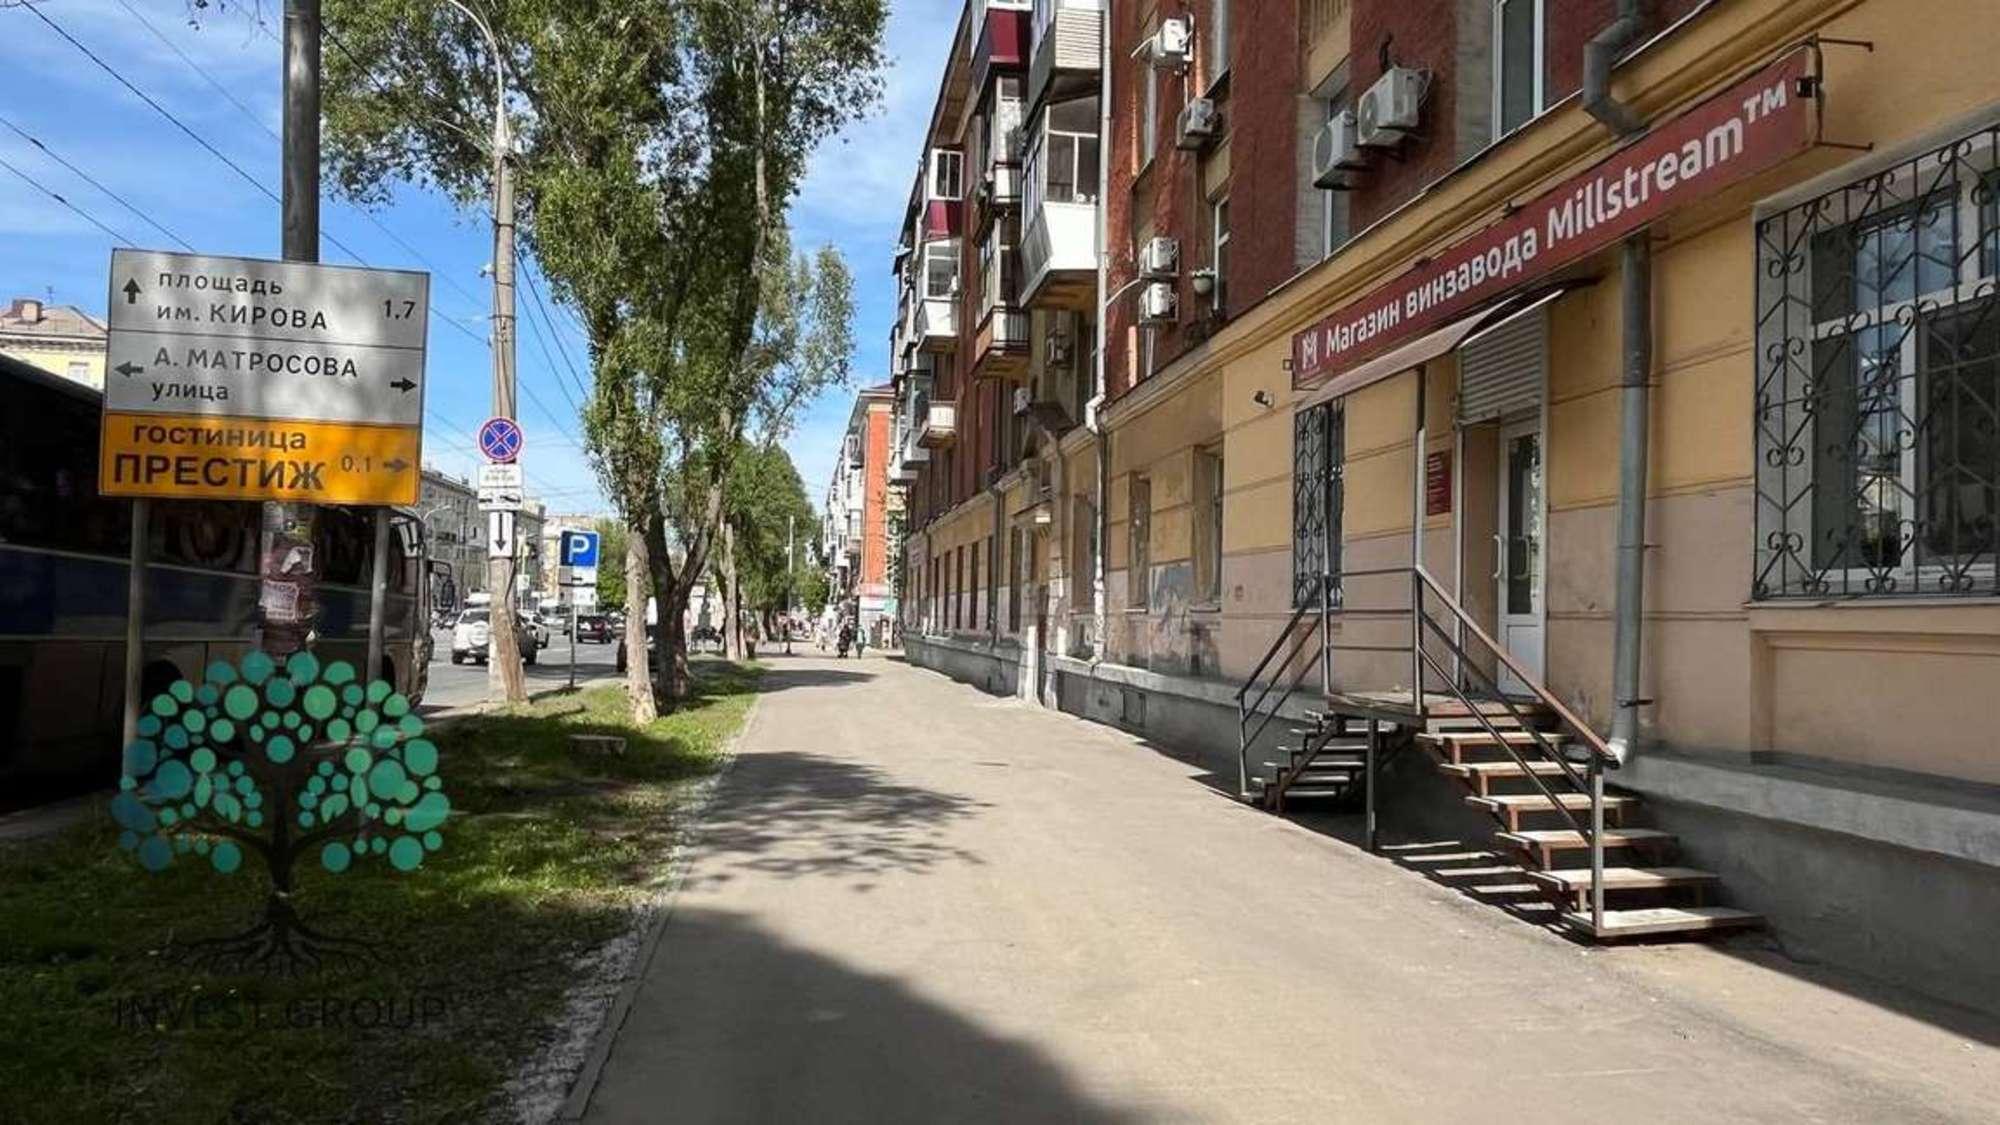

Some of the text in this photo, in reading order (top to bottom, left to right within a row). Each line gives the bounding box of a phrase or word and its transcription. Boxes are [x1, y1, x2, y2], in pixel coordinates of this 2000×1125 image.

[158, 272, 283, 295] площадь
[1325, 297, 1400, 358] Магазин
[1405, 227, 1538, 320] винзавода
[157, 303, 328, 330] им. КИРОВА
[383, 299, 416, 320] 1.7
[153, 346, 358, 378] А. МАТРОСОВА
[151, 381, 229, 401] улица
[133, 423, 307, 451] гостиница
[113, 453, 326, 491] ПРЕСТИЖ
[340, 455, 371, 473] 0.1
